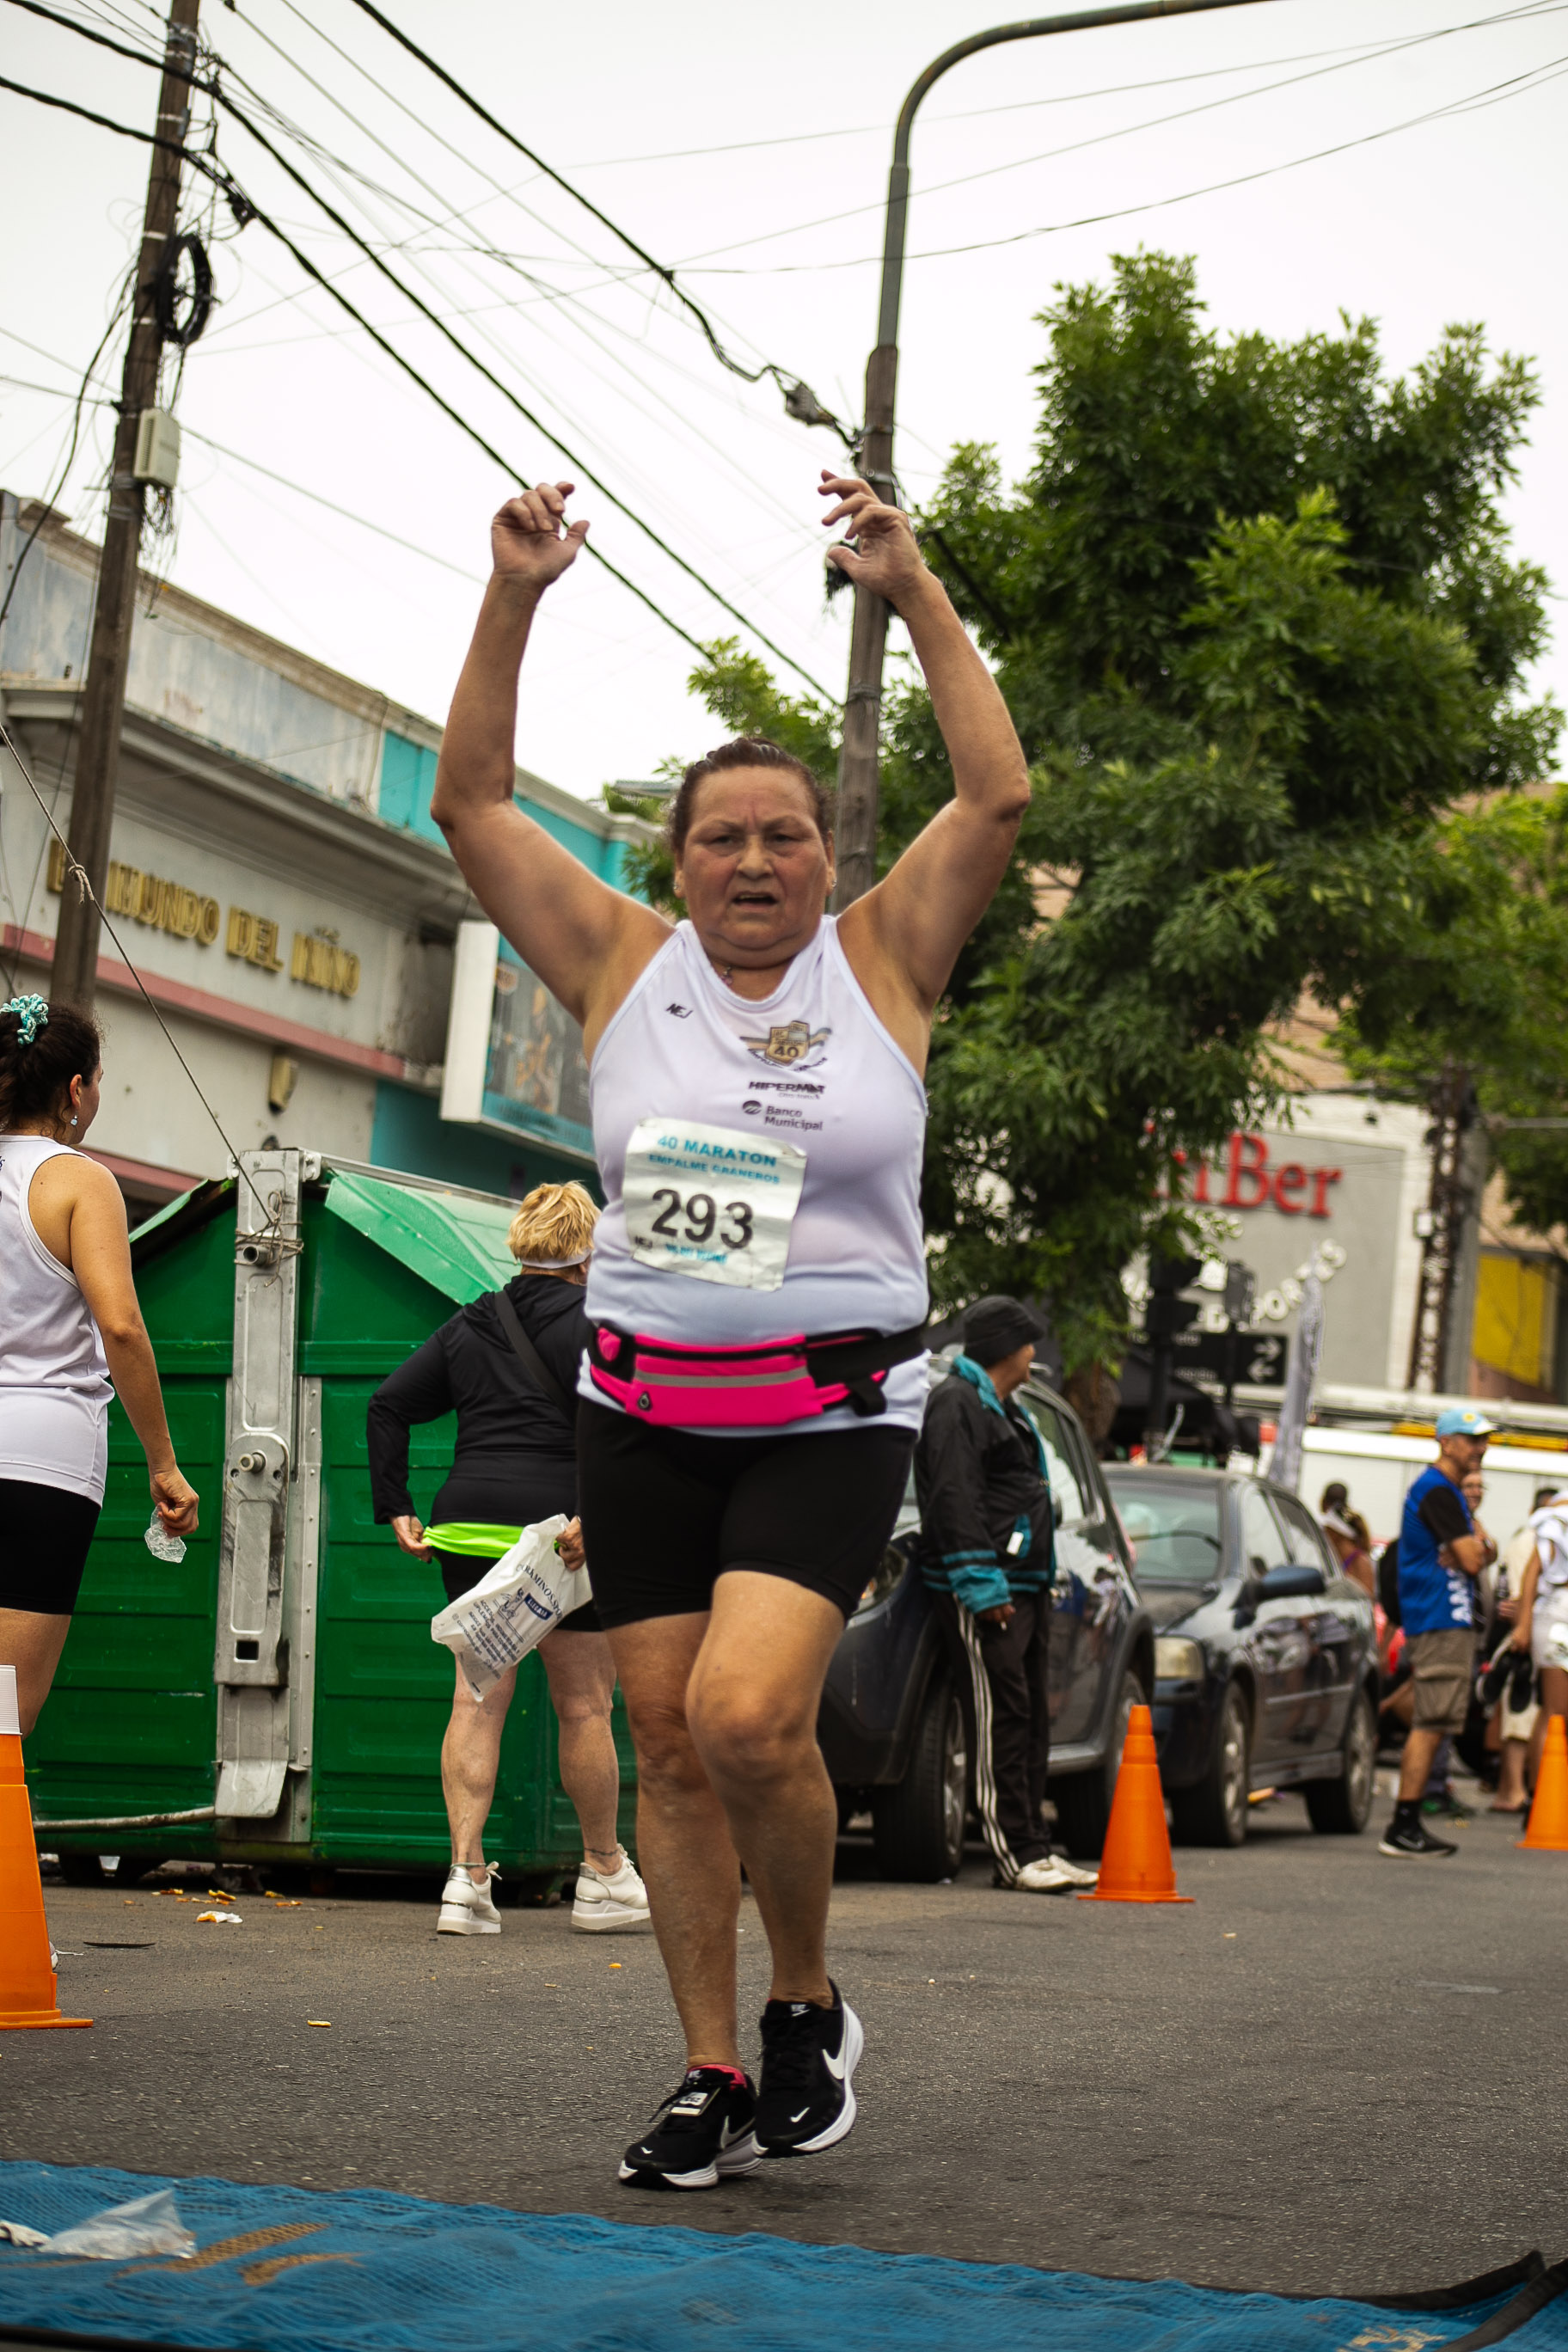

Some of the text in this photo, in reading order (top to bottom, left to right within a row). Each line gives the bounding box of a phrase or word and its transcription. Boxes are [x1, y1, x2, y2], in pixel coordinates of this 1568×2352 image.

[106, 860, 220, 946] MUNDO
[226, 905, 284, 973] DEL
[774, 1045, 799, 1057] 40
[764, 1117, 824, 1131] Municipal
[765, 1106, 802, 1118] Banco
[657, 1135, 777, 1167] 40 MARATON
[647, 1154, 781, 1185] EMPALME GRANEROS
[652, 1189, 753, 1249] 293
